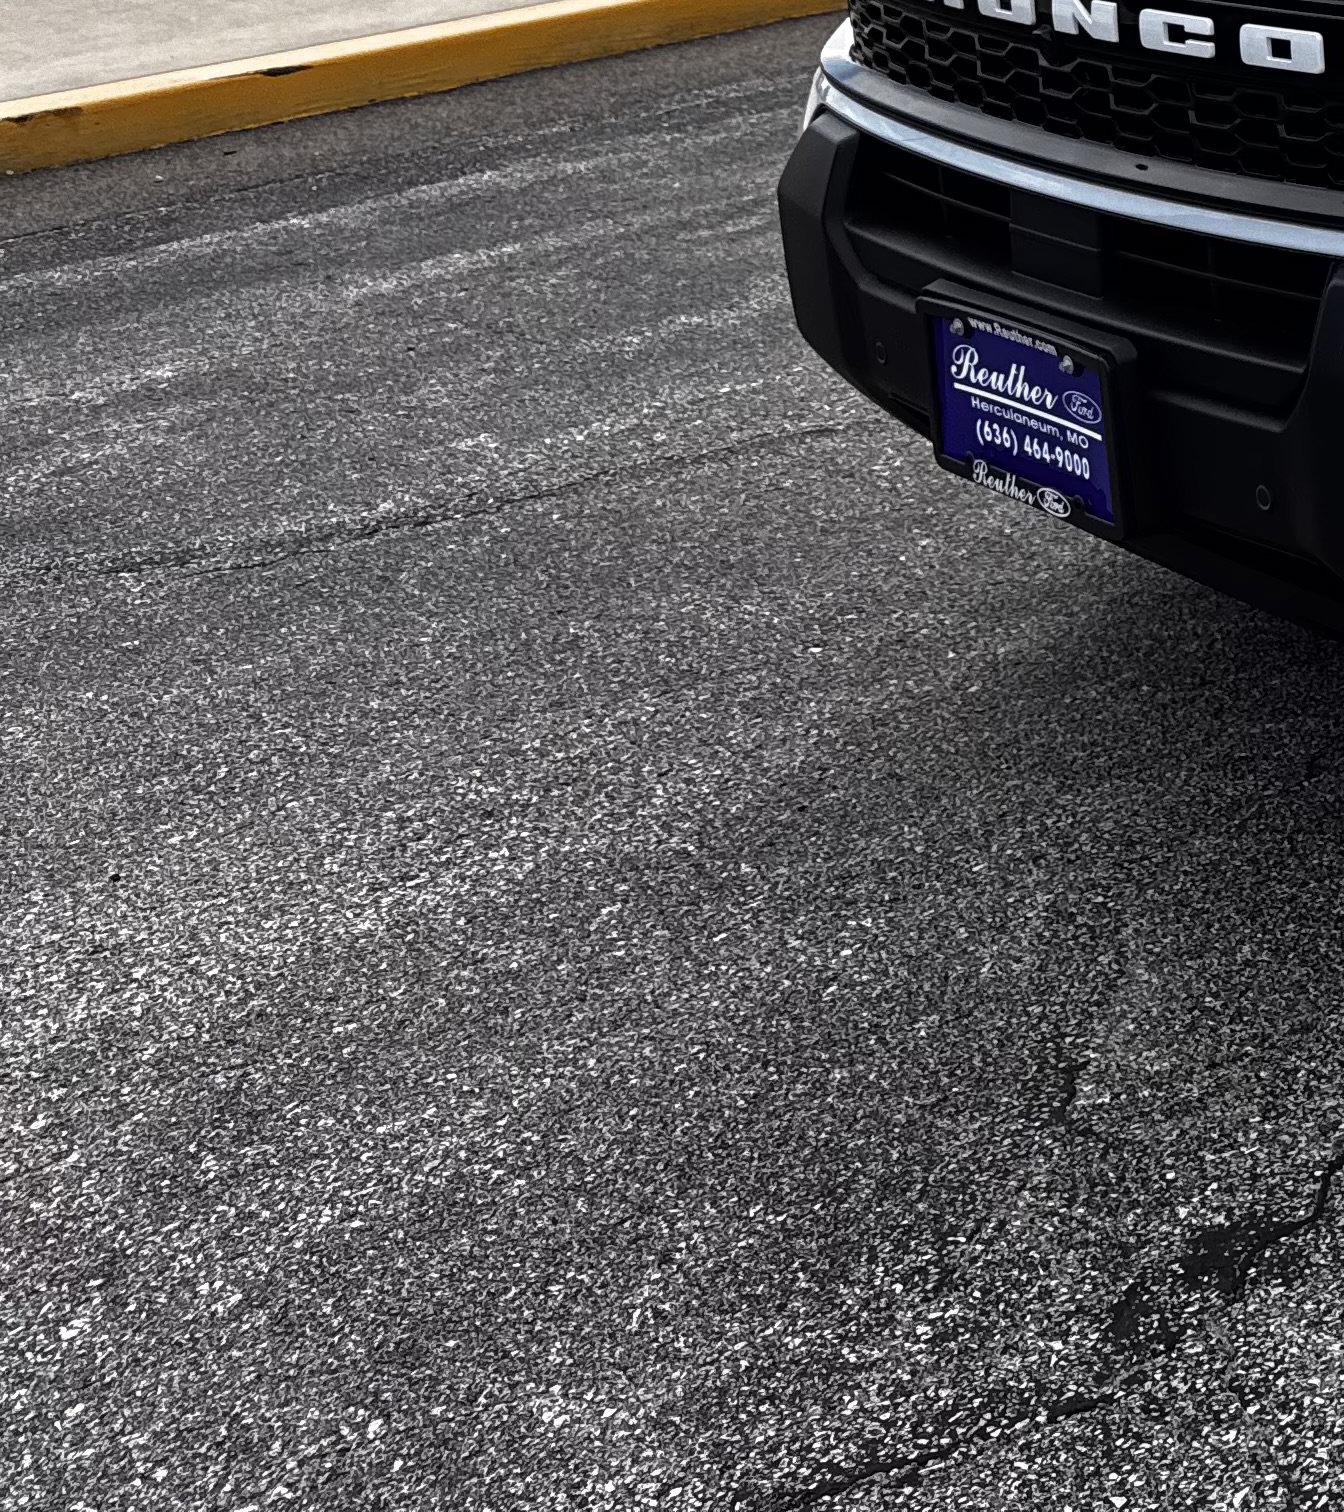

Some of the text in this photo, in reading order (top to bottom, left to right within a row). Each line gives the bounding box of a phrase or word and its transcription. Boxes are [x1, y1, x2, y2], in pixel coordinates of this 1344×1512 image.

[967, 316, 1058, 357] www.Reuther.com
[950, 344, 1095, 420] Reuther Ford
[971, 395, 1089, 449] Herculaneum, MO
[976, 418, 1090, 480] (636) 464-9000
[972, 459, 1065, 514] Reuther Ford
